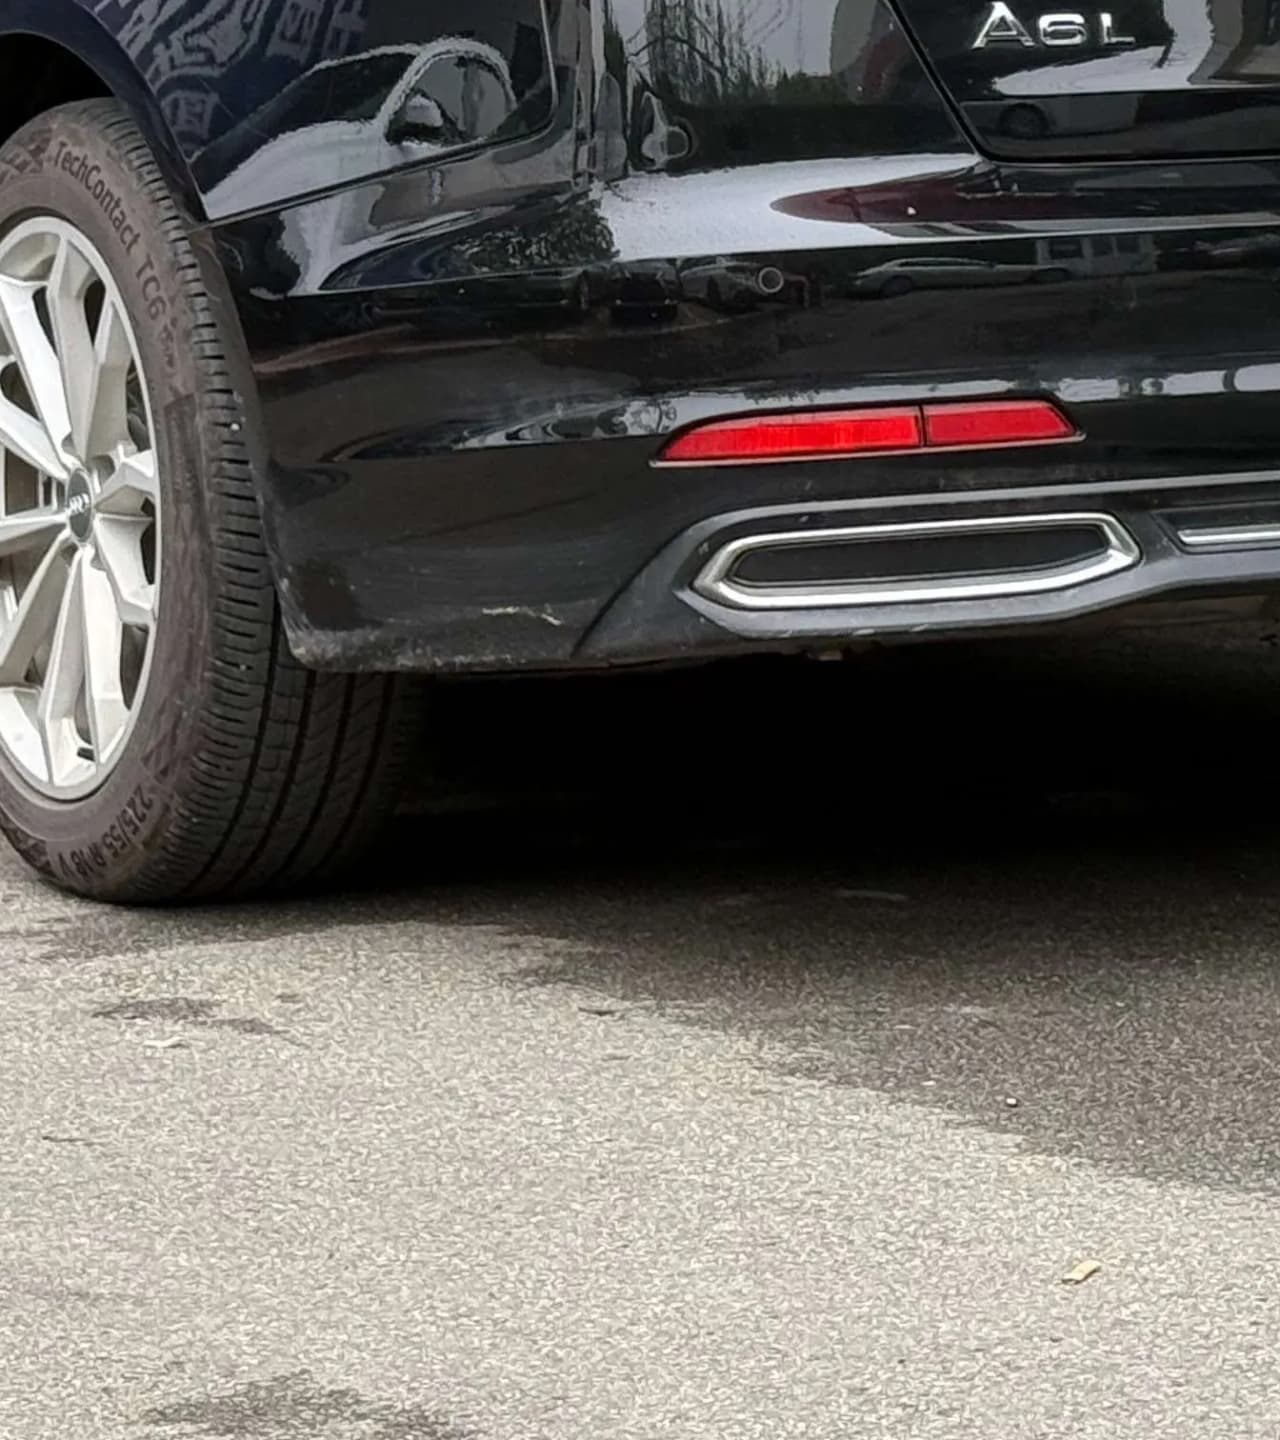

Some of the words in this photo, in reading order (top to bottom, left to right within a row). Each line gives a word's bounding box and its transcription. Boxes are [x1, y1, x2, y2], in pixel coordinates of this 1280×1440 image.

[54, 139, 141, 256] TechContact
[136, 254, 167, 321] TC6
[101, 784, 153, 859] 225/55
